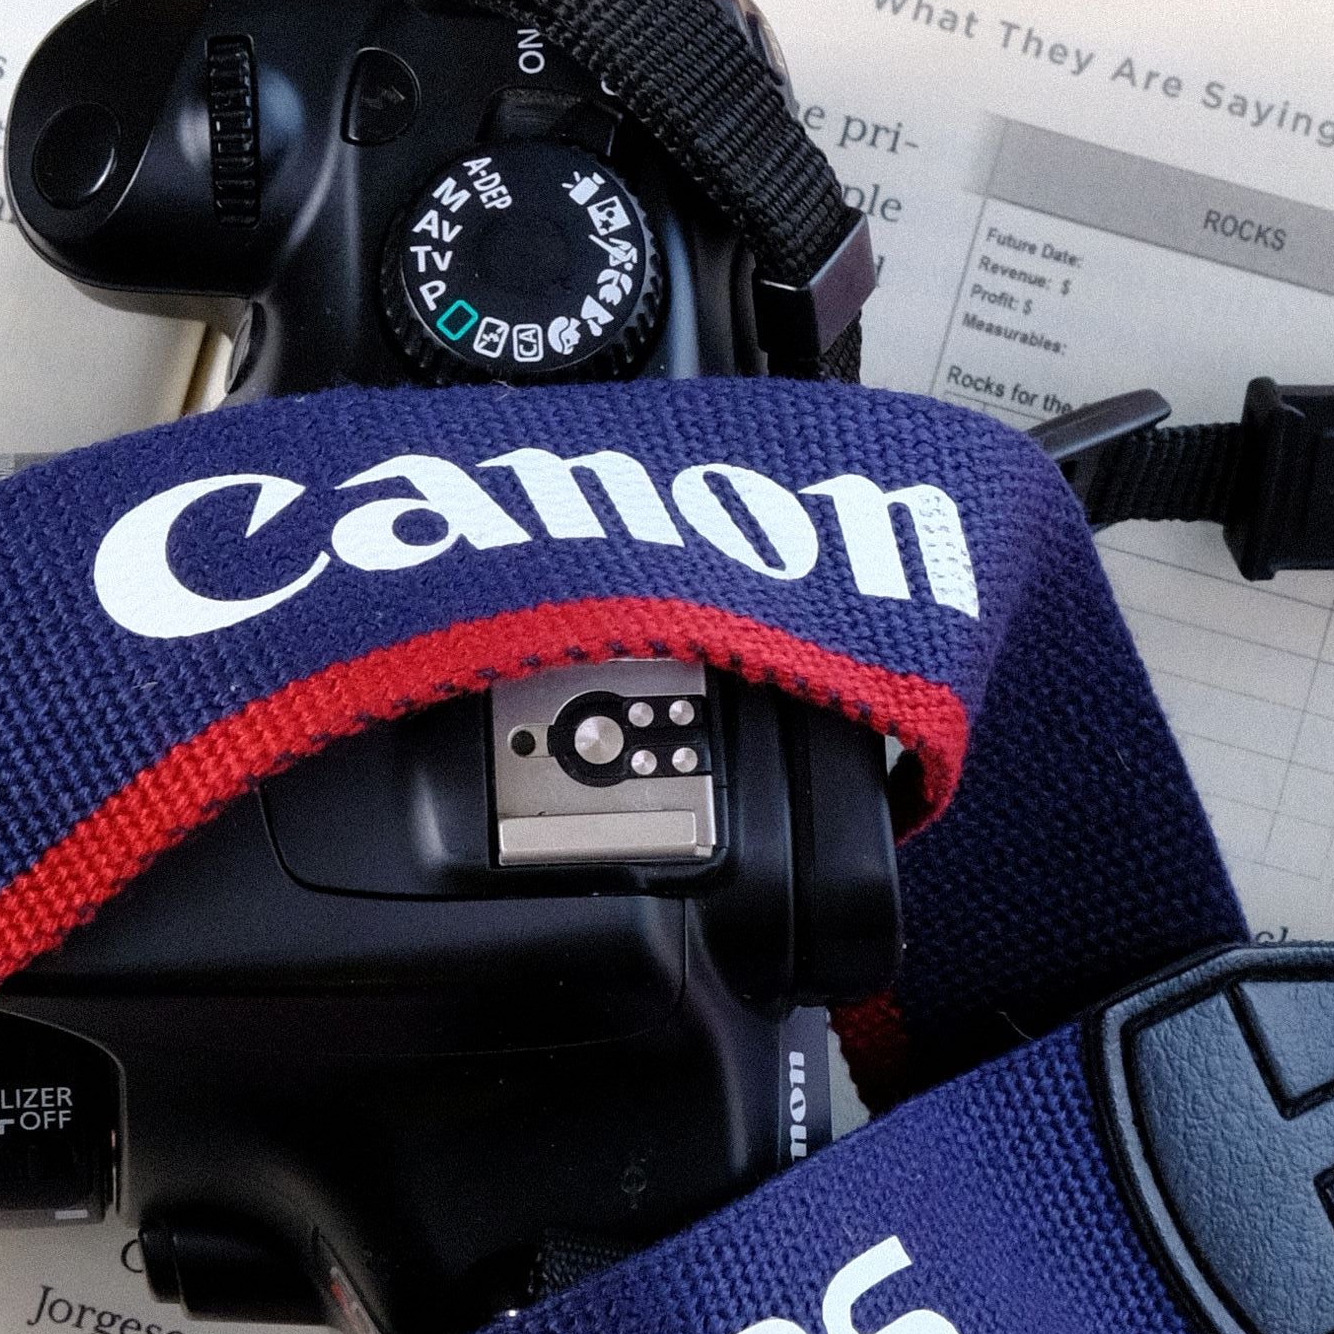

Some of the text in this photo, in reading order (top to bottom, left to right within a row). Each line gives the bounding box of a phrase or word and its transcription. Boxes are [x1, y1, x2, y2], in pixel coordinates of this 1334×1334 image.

[517, 29, 545, 74] ON
[1000, 20, 1095, 76] They
[1110, 56, 1183, 99] Are
[432, 177, 472, 213] M
[462, 157, 513, 210] A-DEP
[412, 209, 464, 243] Av
[1203, 209, 1287, 252] ROCKS
[409, 245, 453, 273] Tv
[987, 227, 1083, 268] Future Date:
[419, 280, 447, 311] P
[979, 256, 1071, 296] Revenue: $
[971, 284, 1033, 315] Profit: $
[962, 313, 1067, 355] Measurables:
[948, 365, 1038, 405] Rocks for
[93, 447, 980, 639] Canon
[20, 1110, 72, 1130] OFF
[788, 1051, 808, 1161] non
